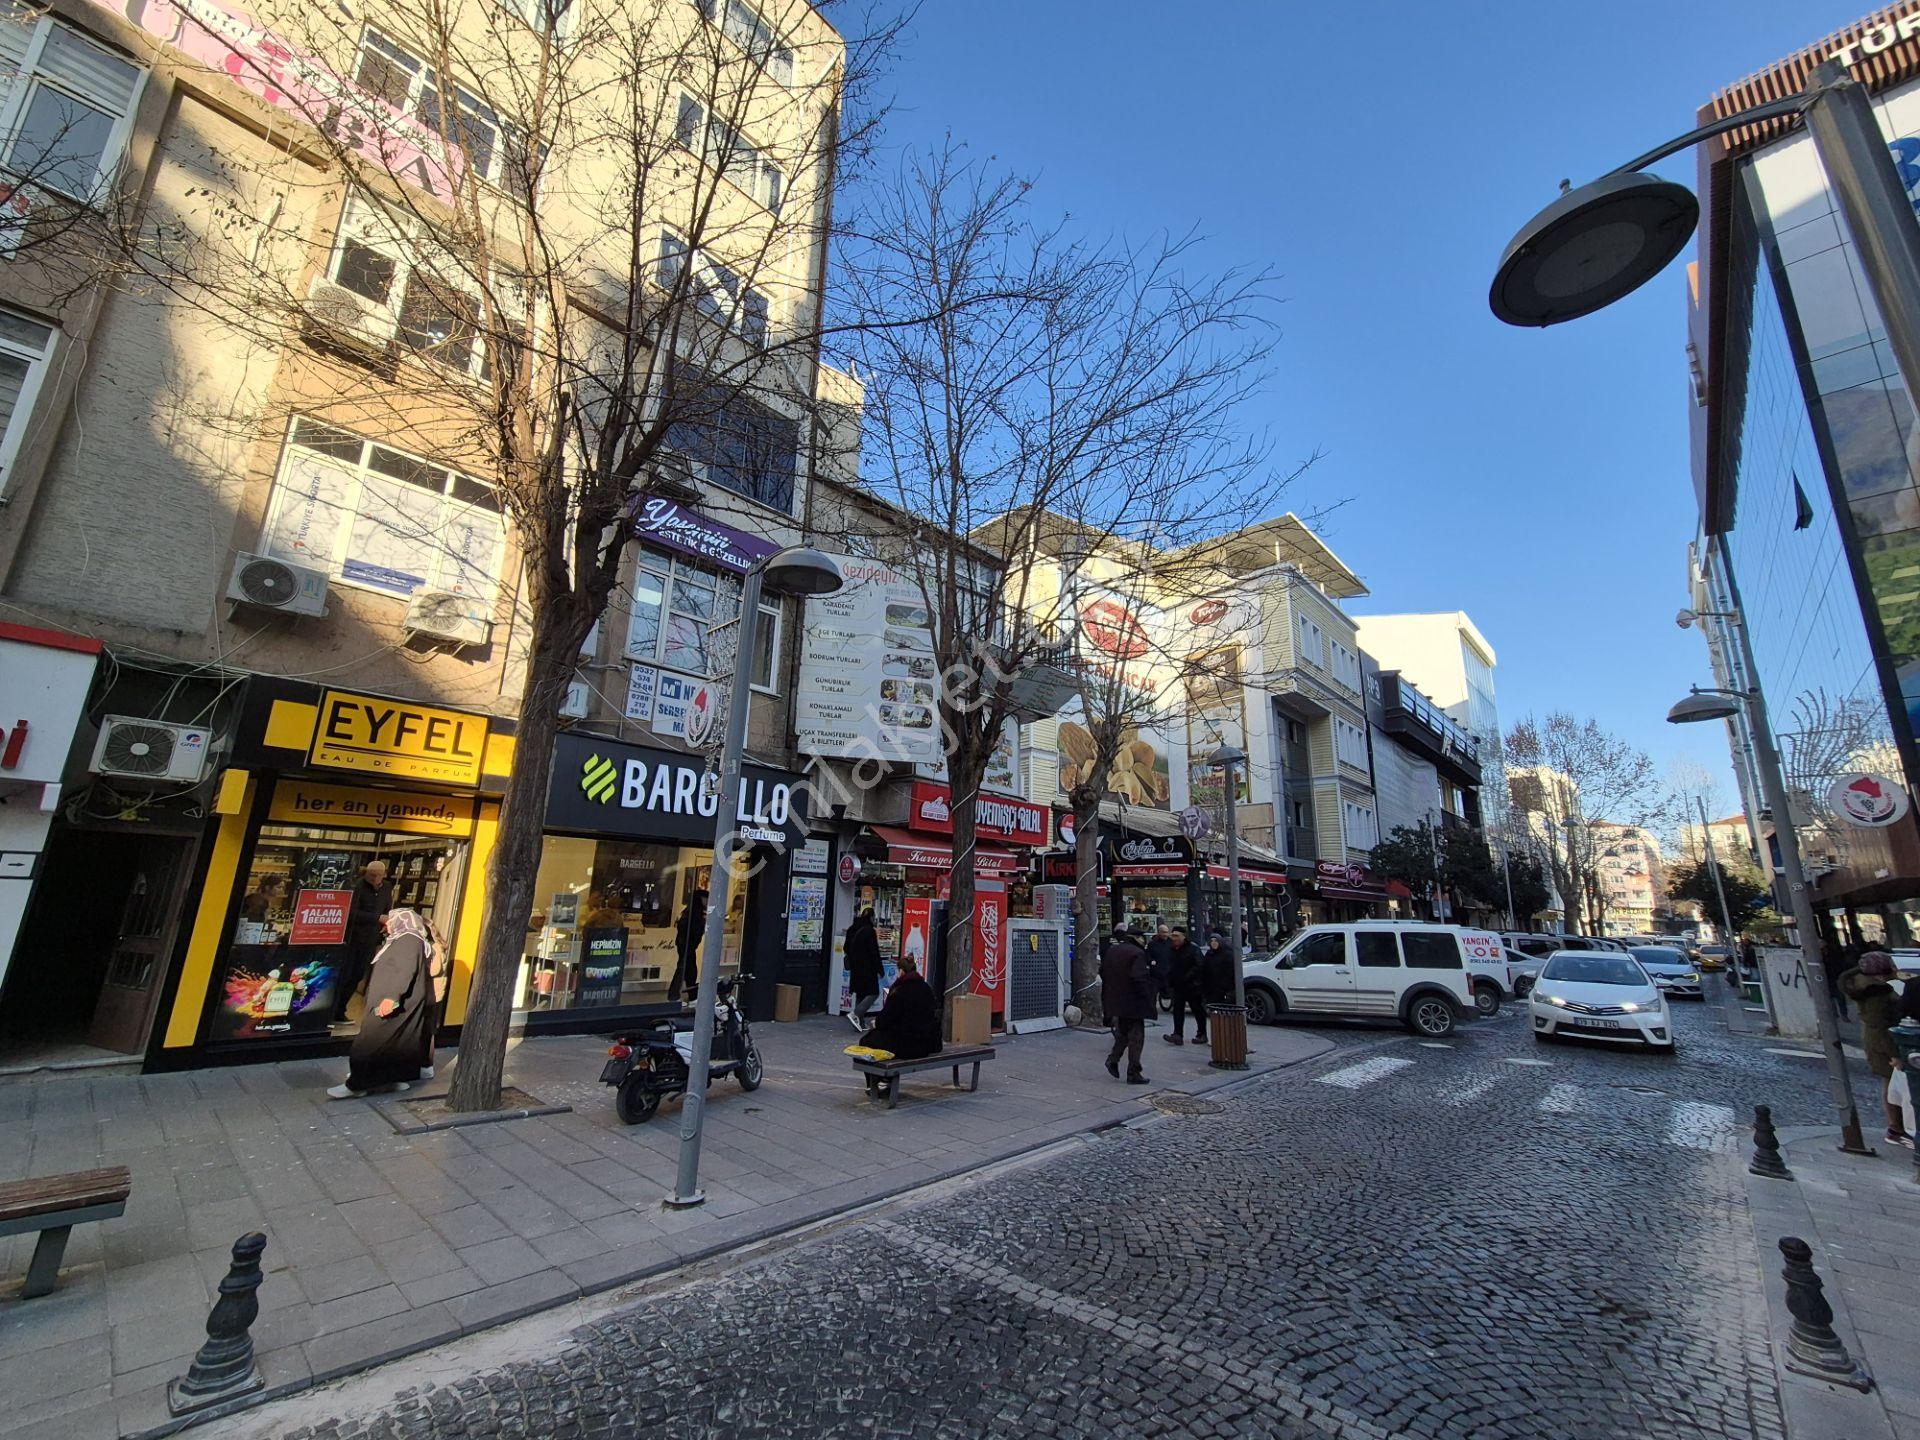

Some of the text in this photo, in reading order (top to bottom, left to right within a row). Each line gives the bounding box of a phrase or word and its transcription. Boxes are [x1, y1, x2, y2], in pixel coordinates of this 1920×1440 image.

[700, 543, 707, 554] &
[326, 700, 473, 757] EYFEL
[320, 753, 472, 778] EAU DE PARFUM
[621, 758, 790, 826] BARGLLO
[294, 793, 456, 825] her an yanında
[975, 799, 1017, 835] UYEMİŞÇİ
[740, 826, 786, 843] Perfume
[620, 858, 655, 870] BARGELLO
[308, 916, 342, 925] BEDAVA
[309, 909, 342, 917] ALANA
[1462, 937, 1490, 946] YANGIN
